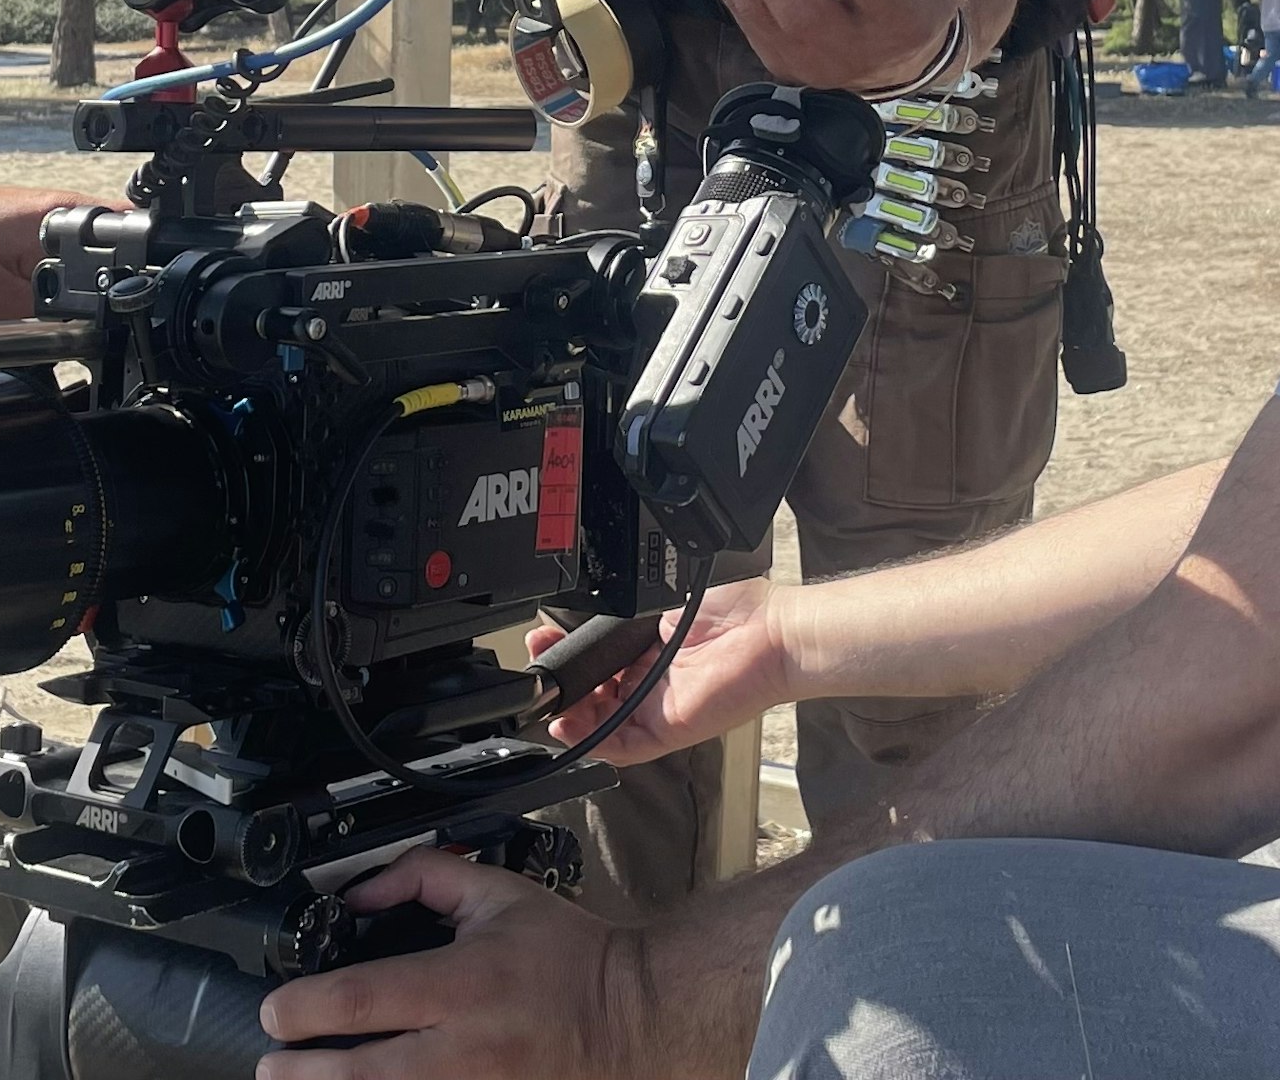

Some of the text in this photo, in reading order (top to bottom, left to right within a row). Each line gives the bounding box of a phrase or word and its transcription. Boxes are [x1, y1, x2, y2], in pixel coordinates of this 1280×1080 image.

[523, 57, 547, 94] tesa
[535, 53, 558, 90] tesa
[311, 281, 345, 301] ARRI
[737, 365, 786, 478] ARRI
[457, 467, 539, 527] ARRI
[75, 805, 118, 834] ARRI
